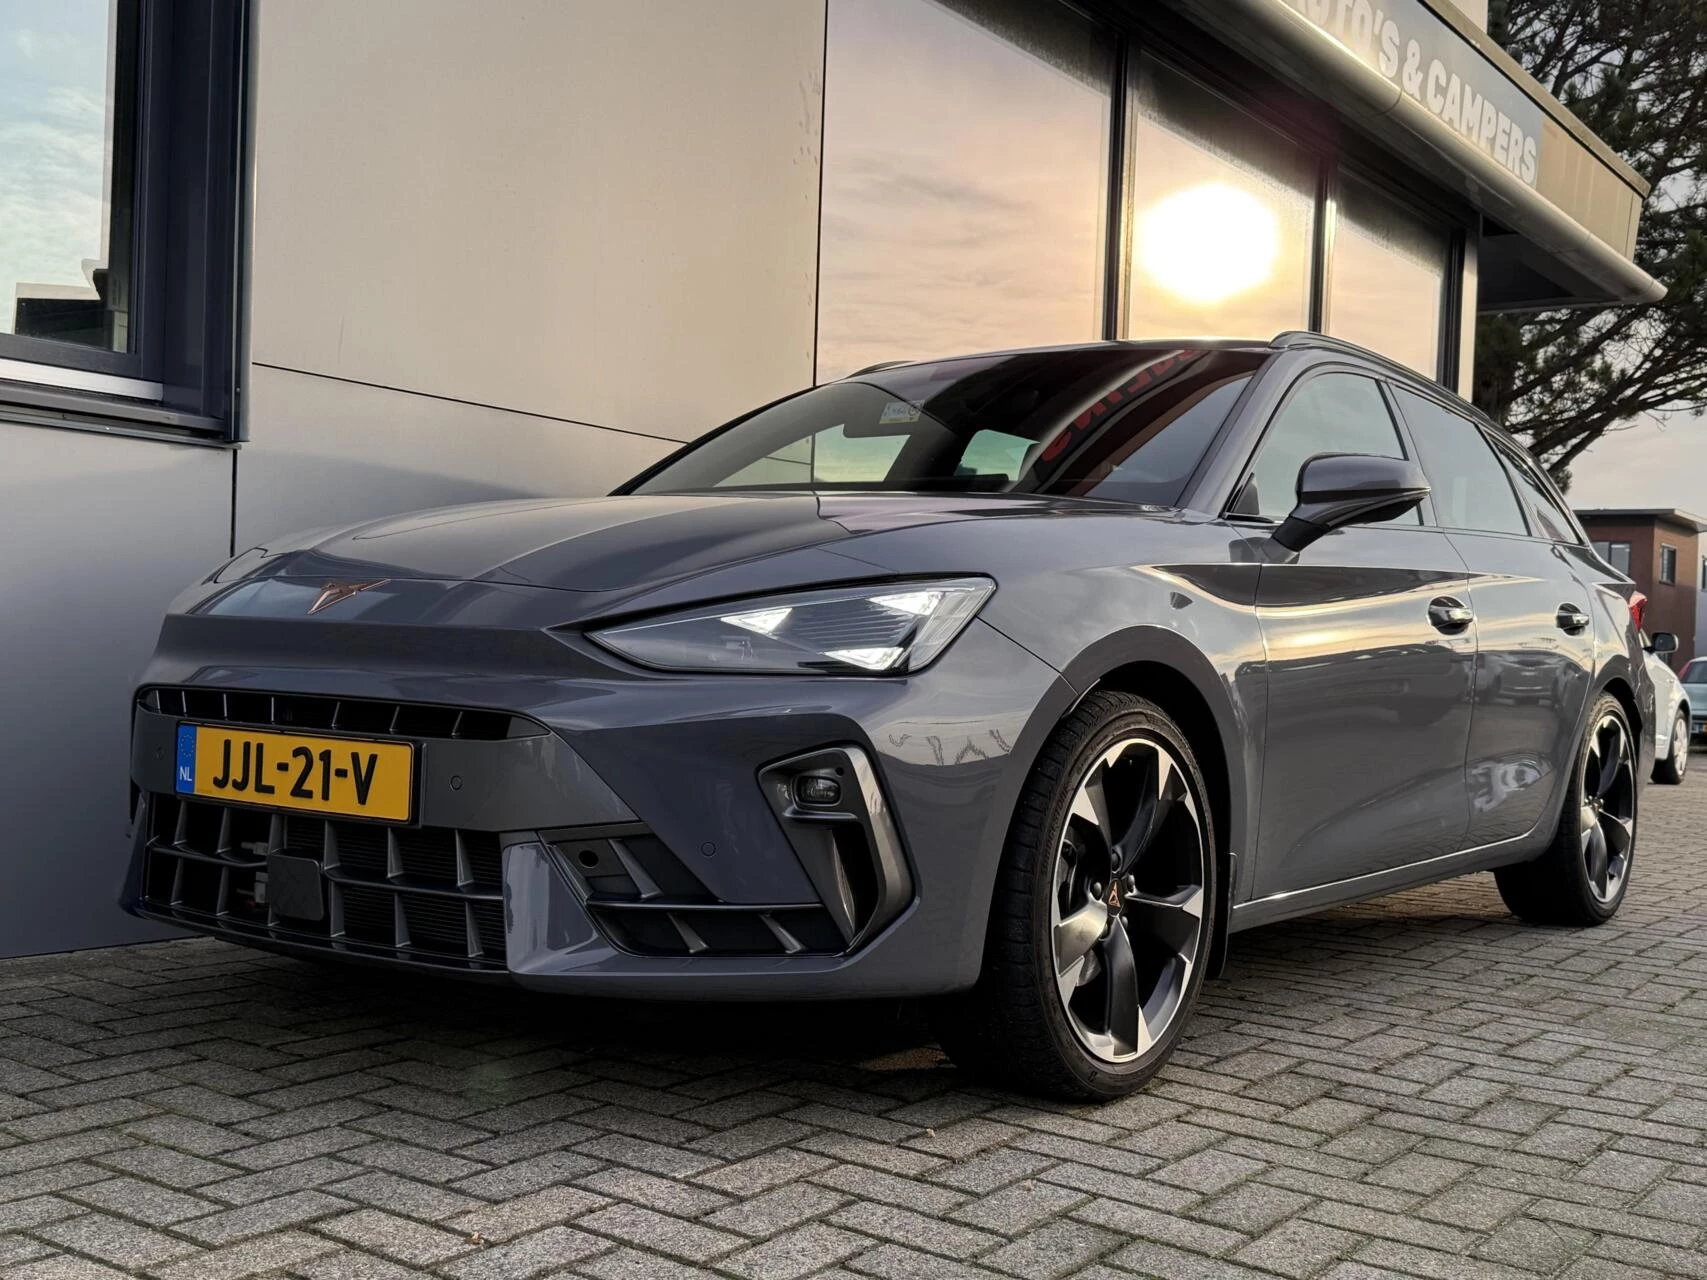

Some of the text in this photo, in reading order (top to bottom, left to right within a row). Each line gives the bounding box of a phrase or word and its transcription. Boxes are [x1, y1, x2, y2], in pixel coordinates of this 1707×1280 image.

[1298, 0, 1537, 184] TO'S & CAMPERS
[179, 766, 192, 782] NL
[212, 739, 378, 806] JJL-21-V
